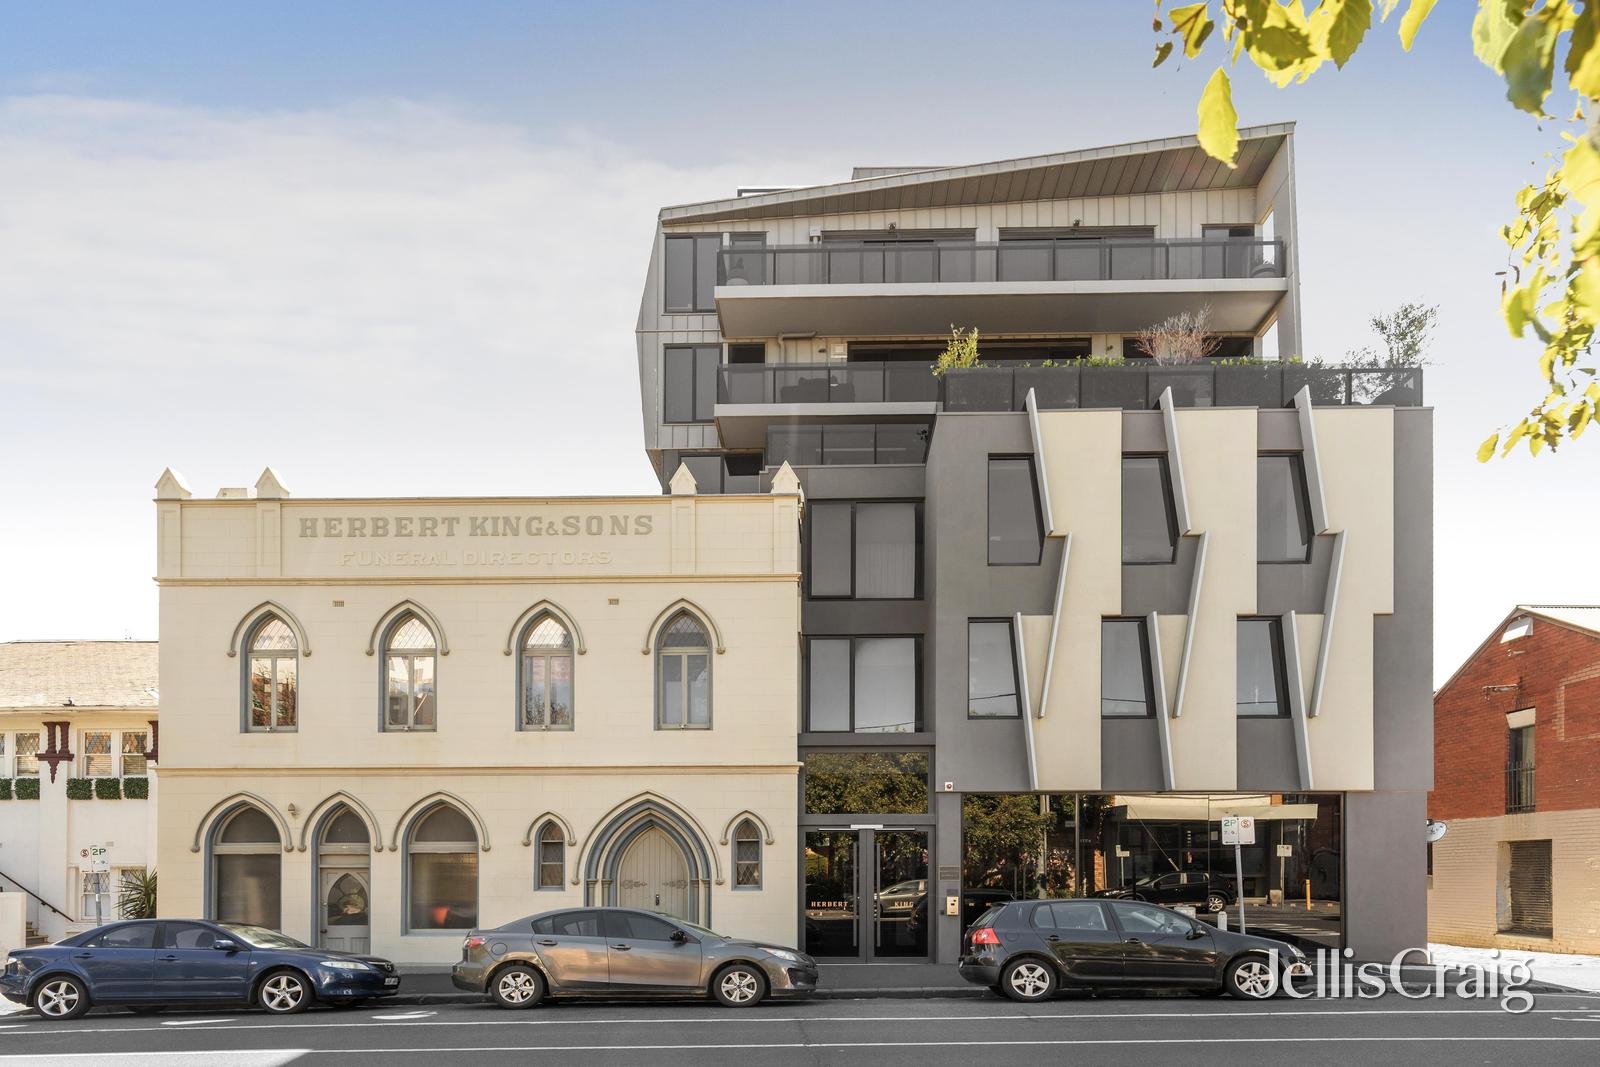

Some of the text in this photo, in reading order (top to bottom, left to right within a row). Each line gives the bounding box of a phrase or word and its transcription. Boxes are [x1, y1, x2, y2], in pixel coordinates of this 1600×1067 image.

[298, 516, 460, 538] HERBERT
[336, 551, 613, 567] FUNERAL DIRECTORS
[1223, 819, 1236, 827] 2P
